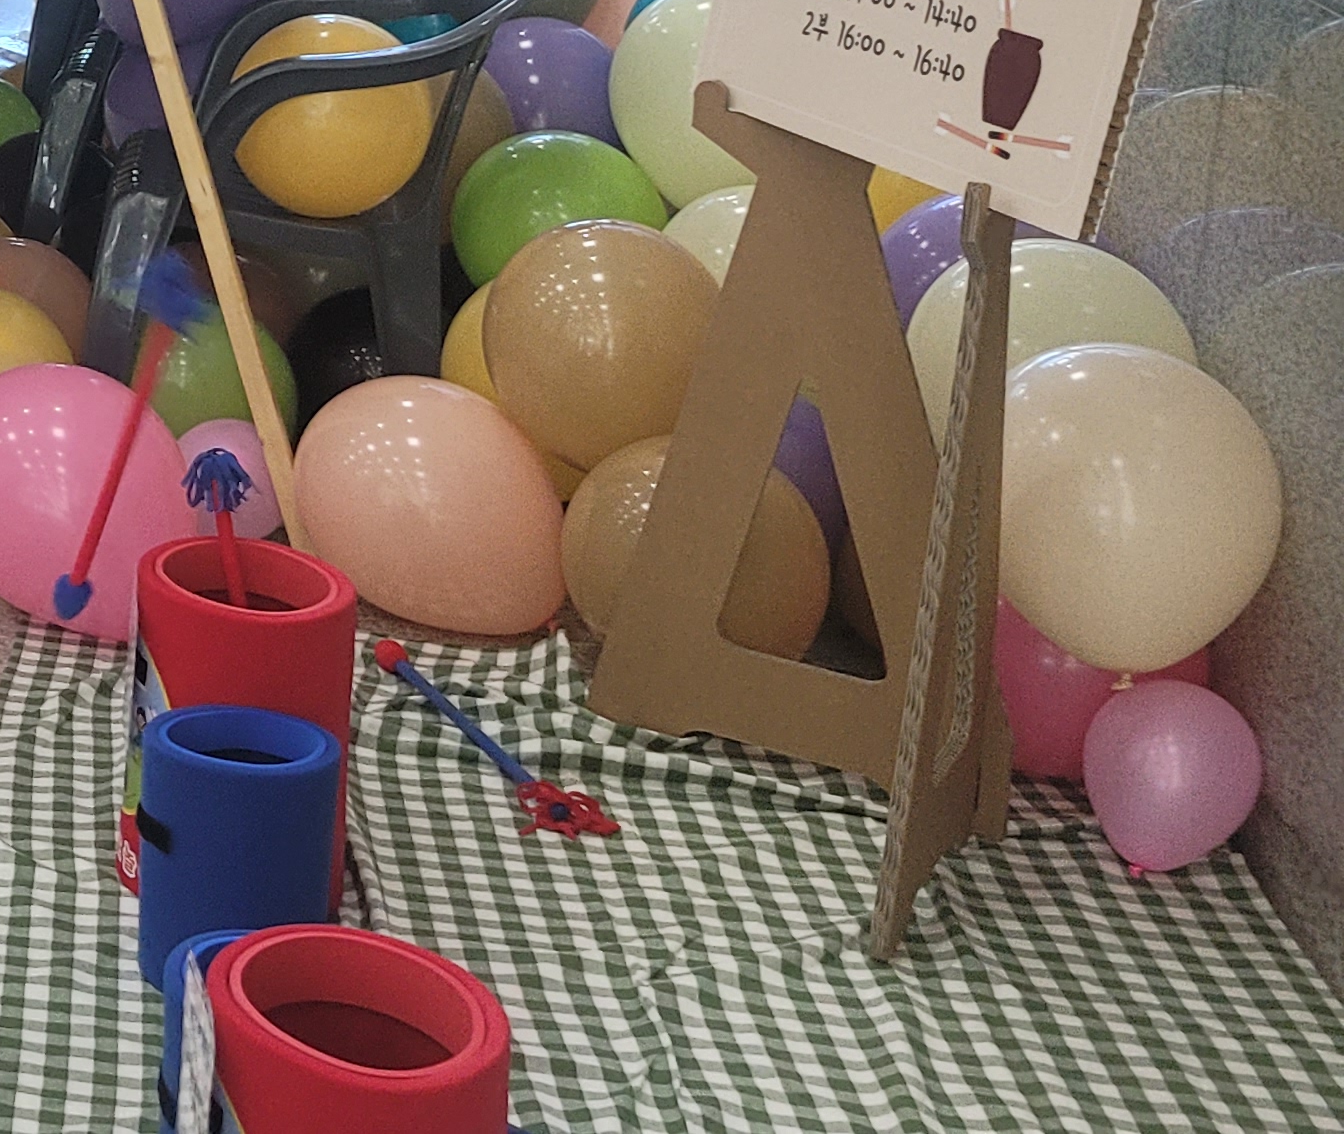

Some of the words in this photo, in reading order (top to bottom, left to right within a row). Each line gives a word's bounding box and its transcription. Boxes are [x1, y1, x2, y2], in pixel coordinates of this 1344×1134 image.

[801, 10, 830, 43] 2부
[837, 20, 886, 57] 16:00
[913, 43, 965, 83] 16:40
